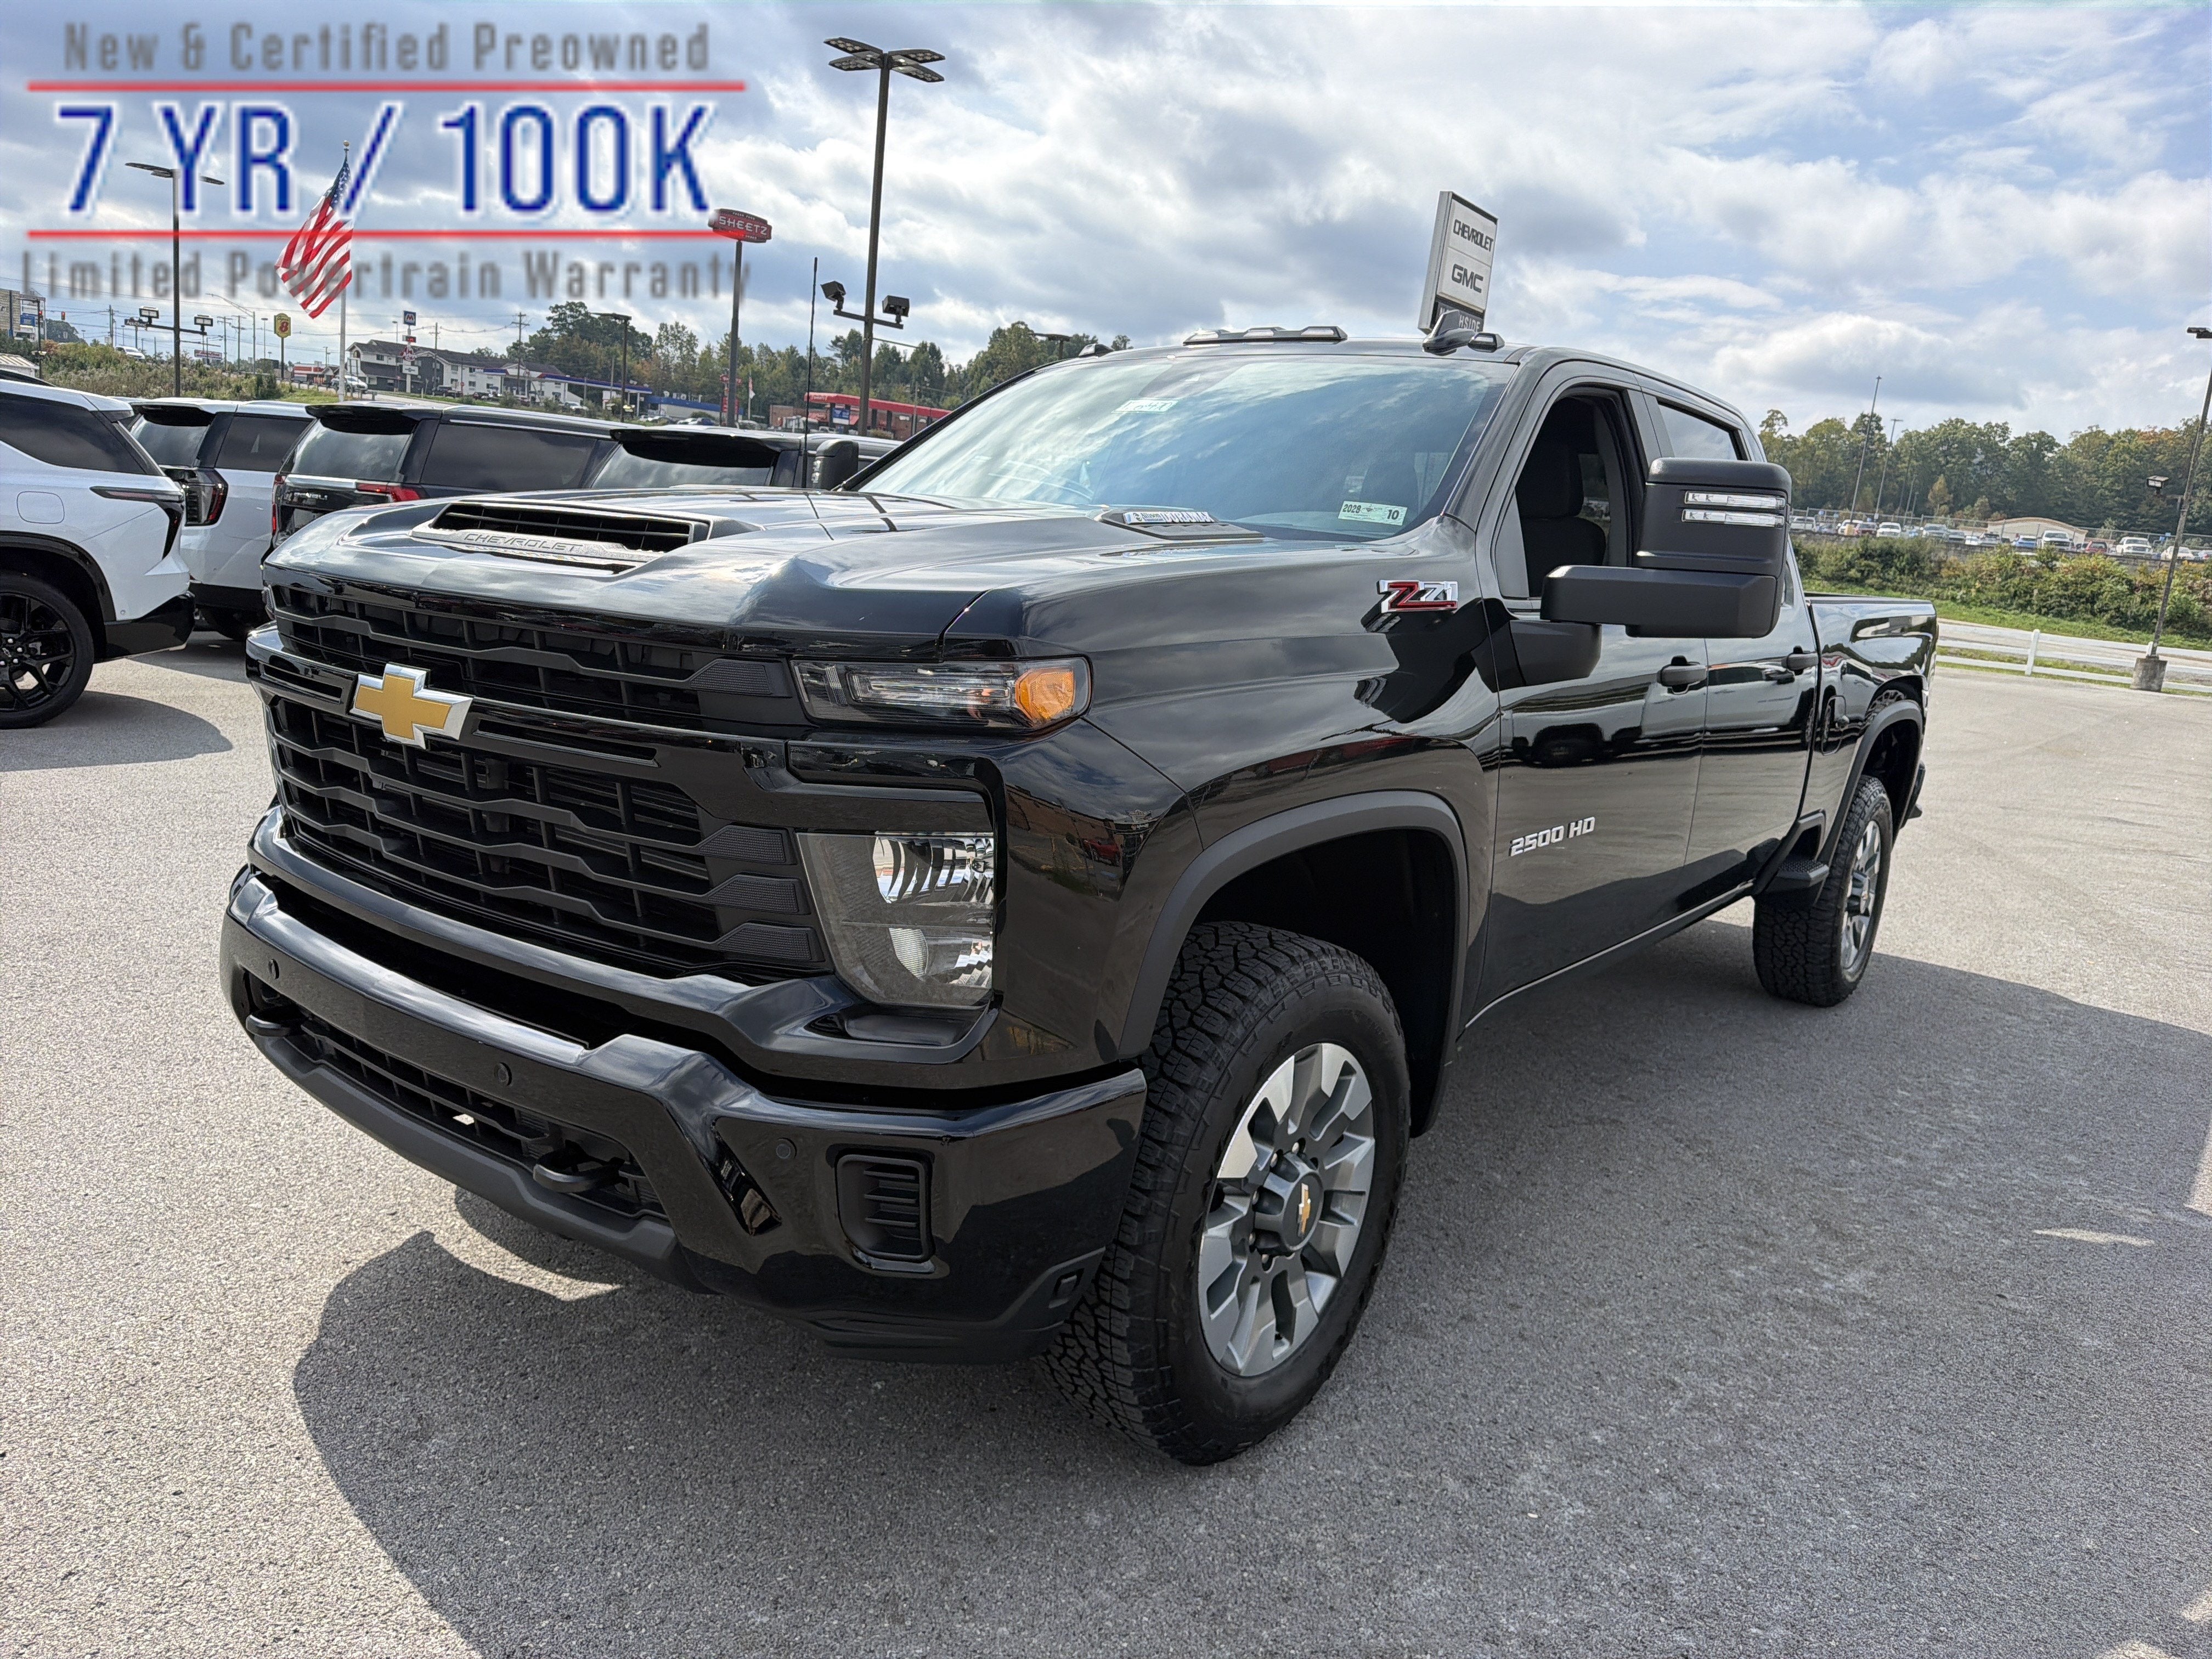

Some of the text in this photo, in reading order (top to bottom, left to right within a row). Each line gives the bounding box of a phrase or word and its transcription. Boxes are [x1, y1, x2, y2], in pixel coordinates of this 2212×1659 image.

[719, 216, 768, 236] SHEETZ
[1453, 218, 1494, 252] CHEVROLET
[1451, 263, 1484, 294] GMC
[279, 321, 289, 332] 8
[1438, 307, 1481, 332] NHSIDE
[1160, 511, 1215, 523] DURAMAX
[1386, 509, 1400, 520] 10
[464, 533, 584, 552] CHEVROLET
[1509, 816, 1595, 857] 2500 HD
